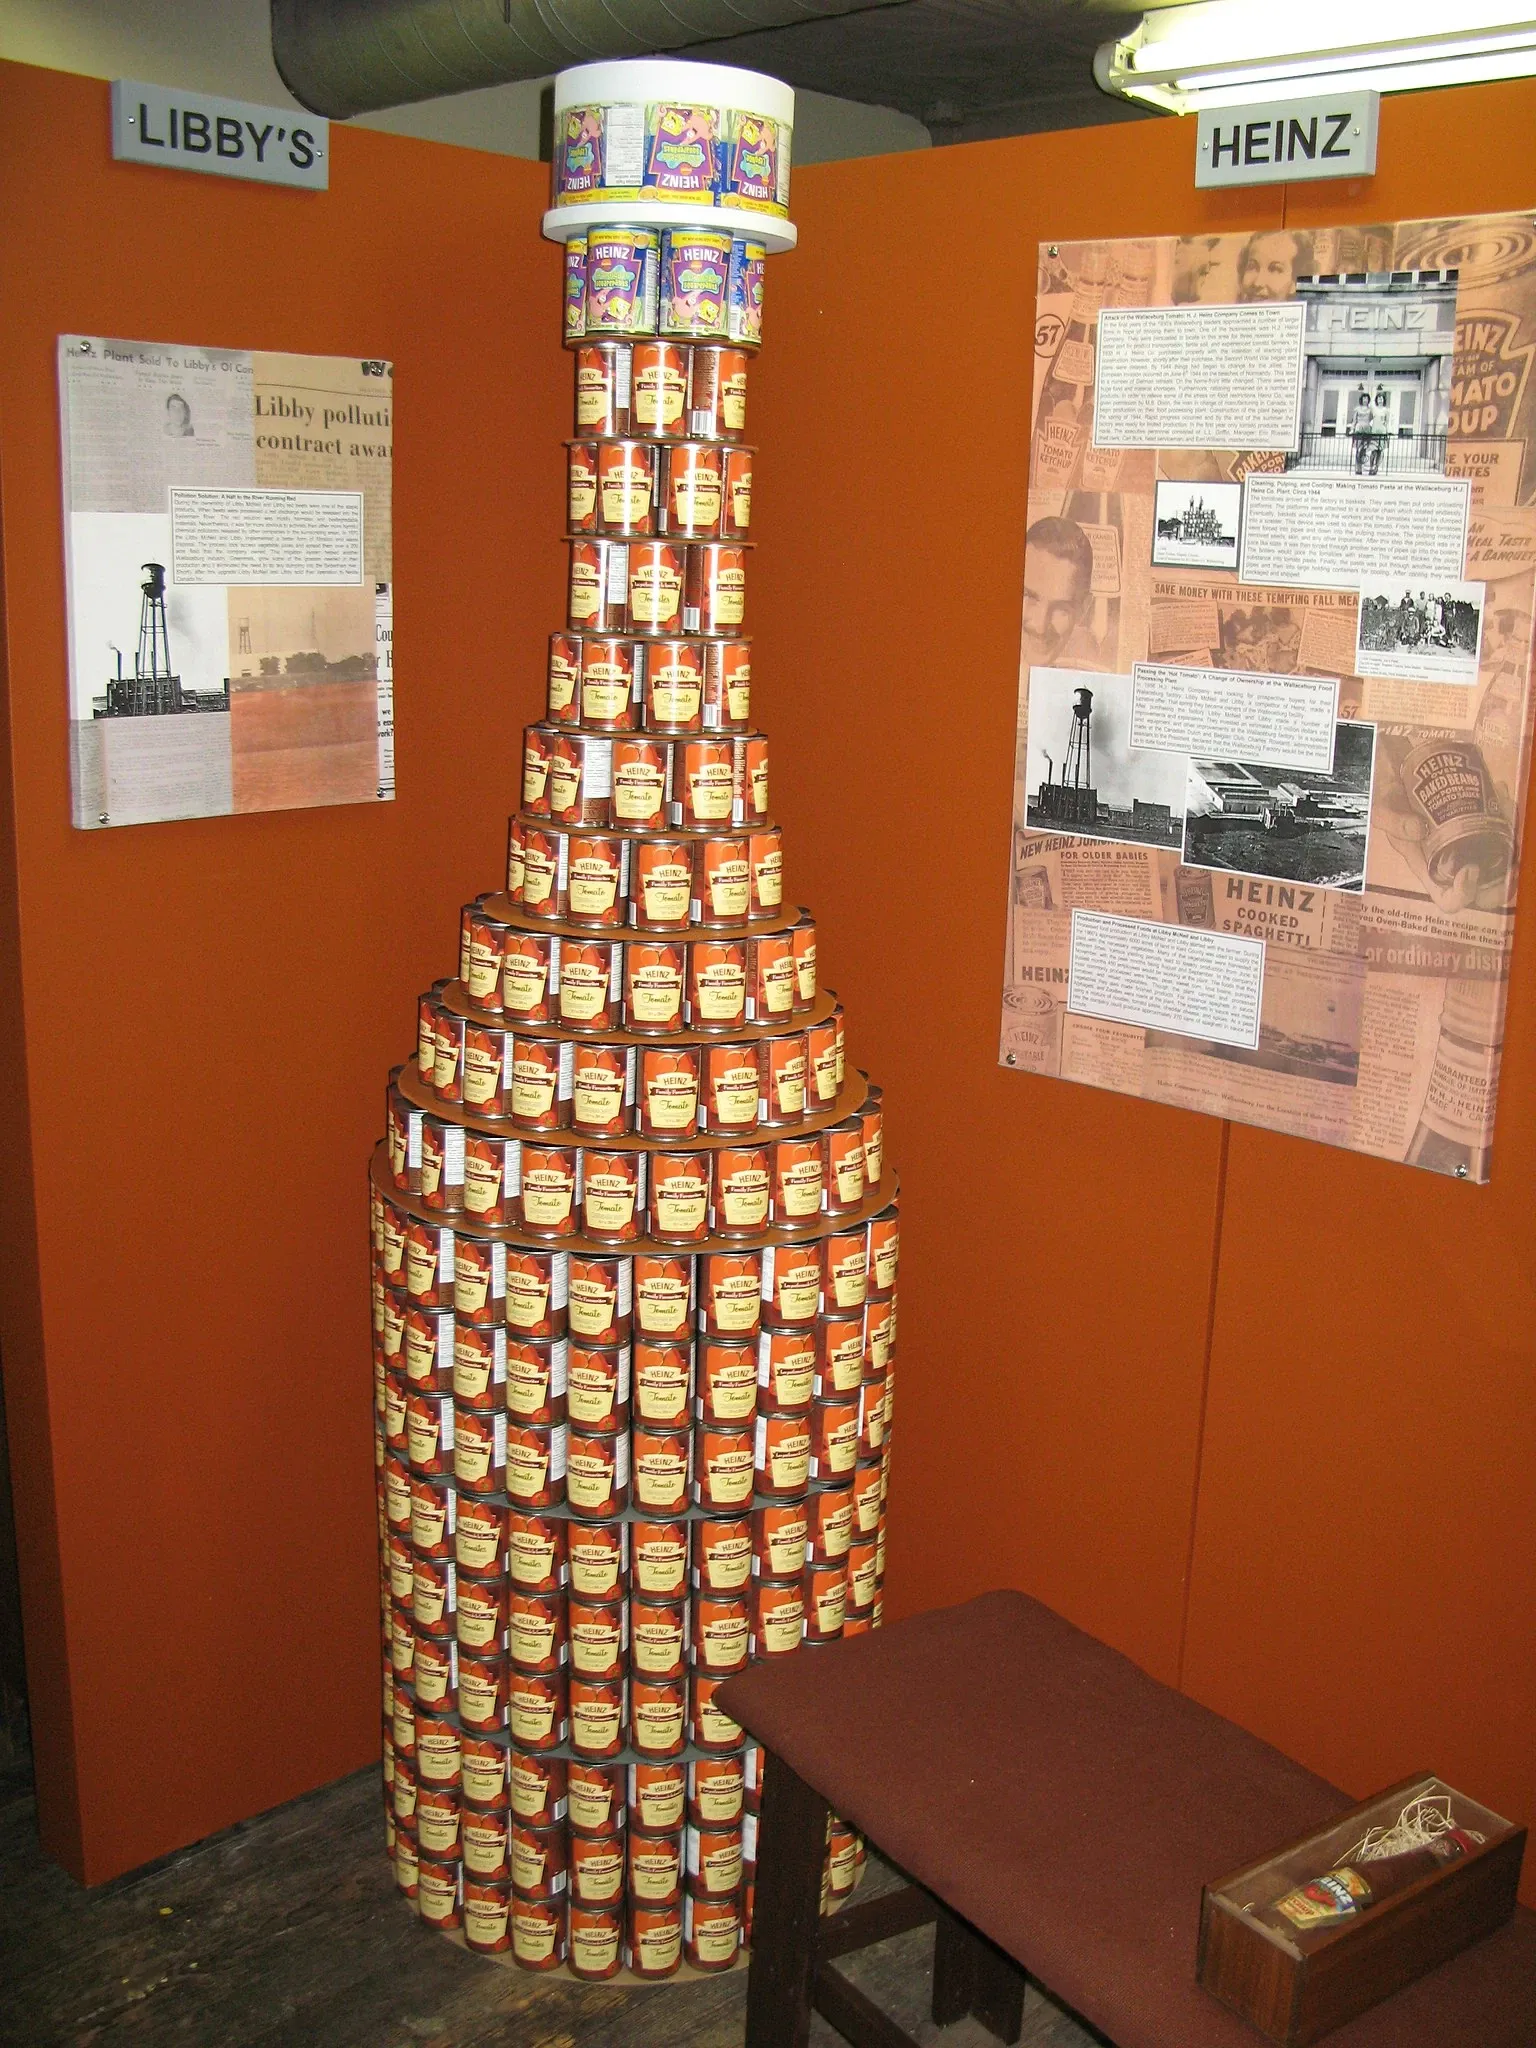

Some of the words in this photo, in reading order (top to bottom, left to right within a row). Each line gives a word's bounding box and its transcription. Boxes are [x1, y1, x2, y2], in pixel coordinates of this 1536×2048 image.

[140, 103, 314, 169] LIBBY'S
[1212, 114, 1351, 168] HEINZ
[568, 176, 590, 189] HEINZ
[662, 174, 699, 188] HEINZ
[742, 182, 767, 198] HEINZ
[596, 248, 630, 259] HEINZ
[684, 249, 719, 263] HEINZ
[1328, 306, 1428, 330] HEINZ
[1037, 325, 1061, 346] 57
[1456, 324, 1505, 353] EINZ
[104, 350, 133, 362] Plant
[166, 358, 179, 368] To
[1481, 361, 1494, 372] OF
[255, 395, 314, 426] Libby
[1448, 405, 1497, 435] OUP
[1050, 426, 1073, 443] HEINZ
[256, 435, 341, 454] contract
[1043, 445, 1072, 458] TOMATO
[1040, 453, 1071, 468] KETCHUP
[1464, 454, 1499, 464] YOUR
[1471, 552, 1480, 561] A
[1155, 584, 1175, 595] SAVE
[1179, 586, 1207, 599] MONEY
[1211, 589, 1233, 600] WITH
[1236, 591, 1262, 603] THESE
[1267, 593, 1308, 605] TEMPTING
[1314, 595, 1334, 606] FALL
[1341, 706, 1360, 719] 57
[1419, 730, 1456, 738] TOMATO
[627, 768, 650, 776] HEINZ
[707, 767, 728, 776] HEINZ
[1420, 754, 1463, 778] HEINZ
[1431, 767, 1456, 779] OVEN
[1420, 776, 1448, 802] BAKED
[1448, 773, 1480, 786] BEANS
[1020, 841, 1043, 860] NEW
[1045, 836, 1075, 852] HEINZ
[1083, 852, 1112, 860] OLDER
[1117, 852, 1148, 860] BABIES
[579, 862, 603, 872] HEINZ
[659, 869, 682, 878] HEINZ
[1227, 878, 1315, 913] HEINZ
[1238, 908, 1298, 928] COOKED
[1372, 905, 1384, 914] the
[1388, 909, 1422, 921] old-time
[1425, 915, 1449, 925] Heinz
[1452, 920, 1479, 931] recipe
[1223, 919, 1310, 946] SPAGHETTI
[1376, 916, 1428, 932] Oven-Baked
[1431, 927, 1457, 938] Beans
[1460, 931, 1476, 941] like
[1386, 945, 1462, 973] ordinary
[645, 970, 670, 978] HEINZ
[1014, 1031, 1039, 1045] HEINZ
[584, 1072, 608, 1081] HEINZ
[1436, 1060, 1487, 1086] GUARANTEED
[664, 1077, 687, 1085] HEINZ
[534, 1173, 559, 1183] HEINZ
[739, 1174, 761, 1183] HEINZ
[796, 1270, 816, 1279] HEINZ
[650, 1282, 675, 1291] HEINZ
[730, 1280, 752, 1289] HEINZ
[650, 1370, 675, 1378] HEINZ
[517, 1536, 538, 1545] HEINZ
[582, 1548, 605, 1556] HEINZ
[590, 1858, 613, 1866] HEINZ
